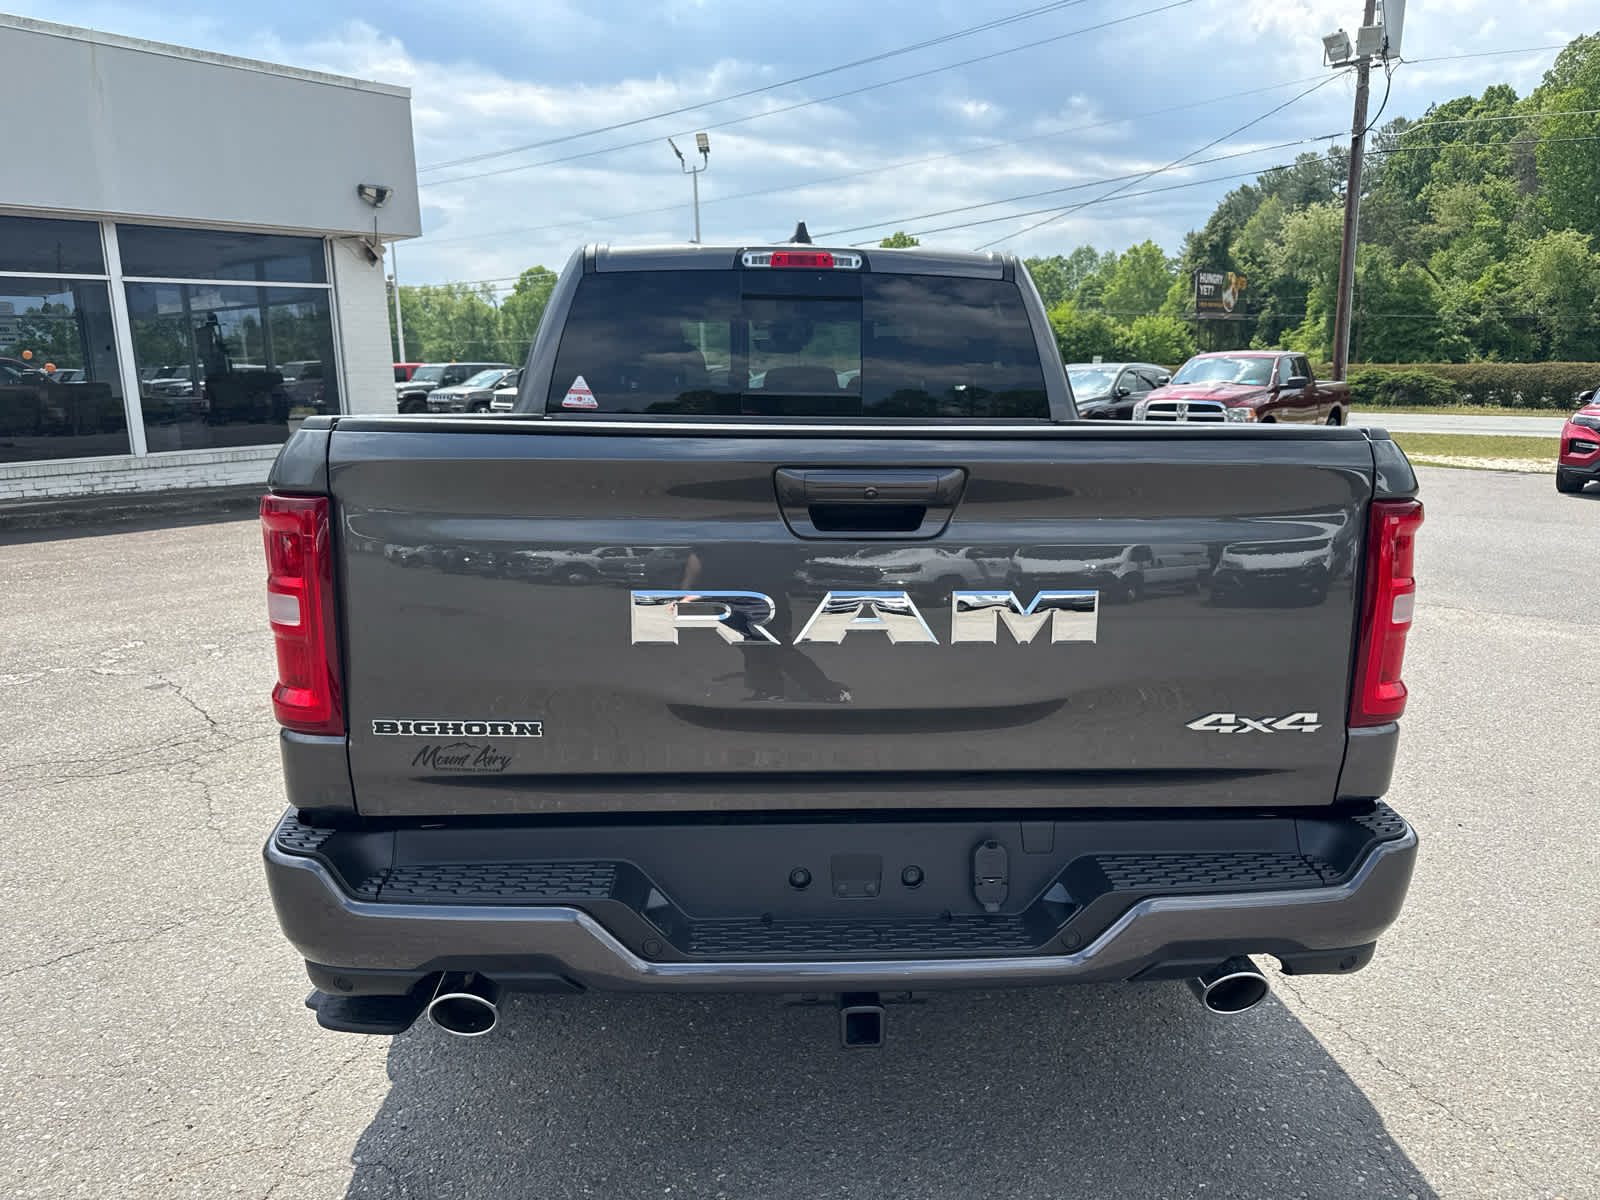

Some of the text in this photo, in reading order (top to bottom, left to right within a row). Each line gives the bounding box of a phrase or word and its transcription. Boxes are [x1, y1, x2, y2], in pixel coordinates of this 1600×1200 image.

[631, 590, 1100, 646] RAM
[372, 719, 544, 738] BIGHORN
[411, 744, 512, 771] Mount Airy
